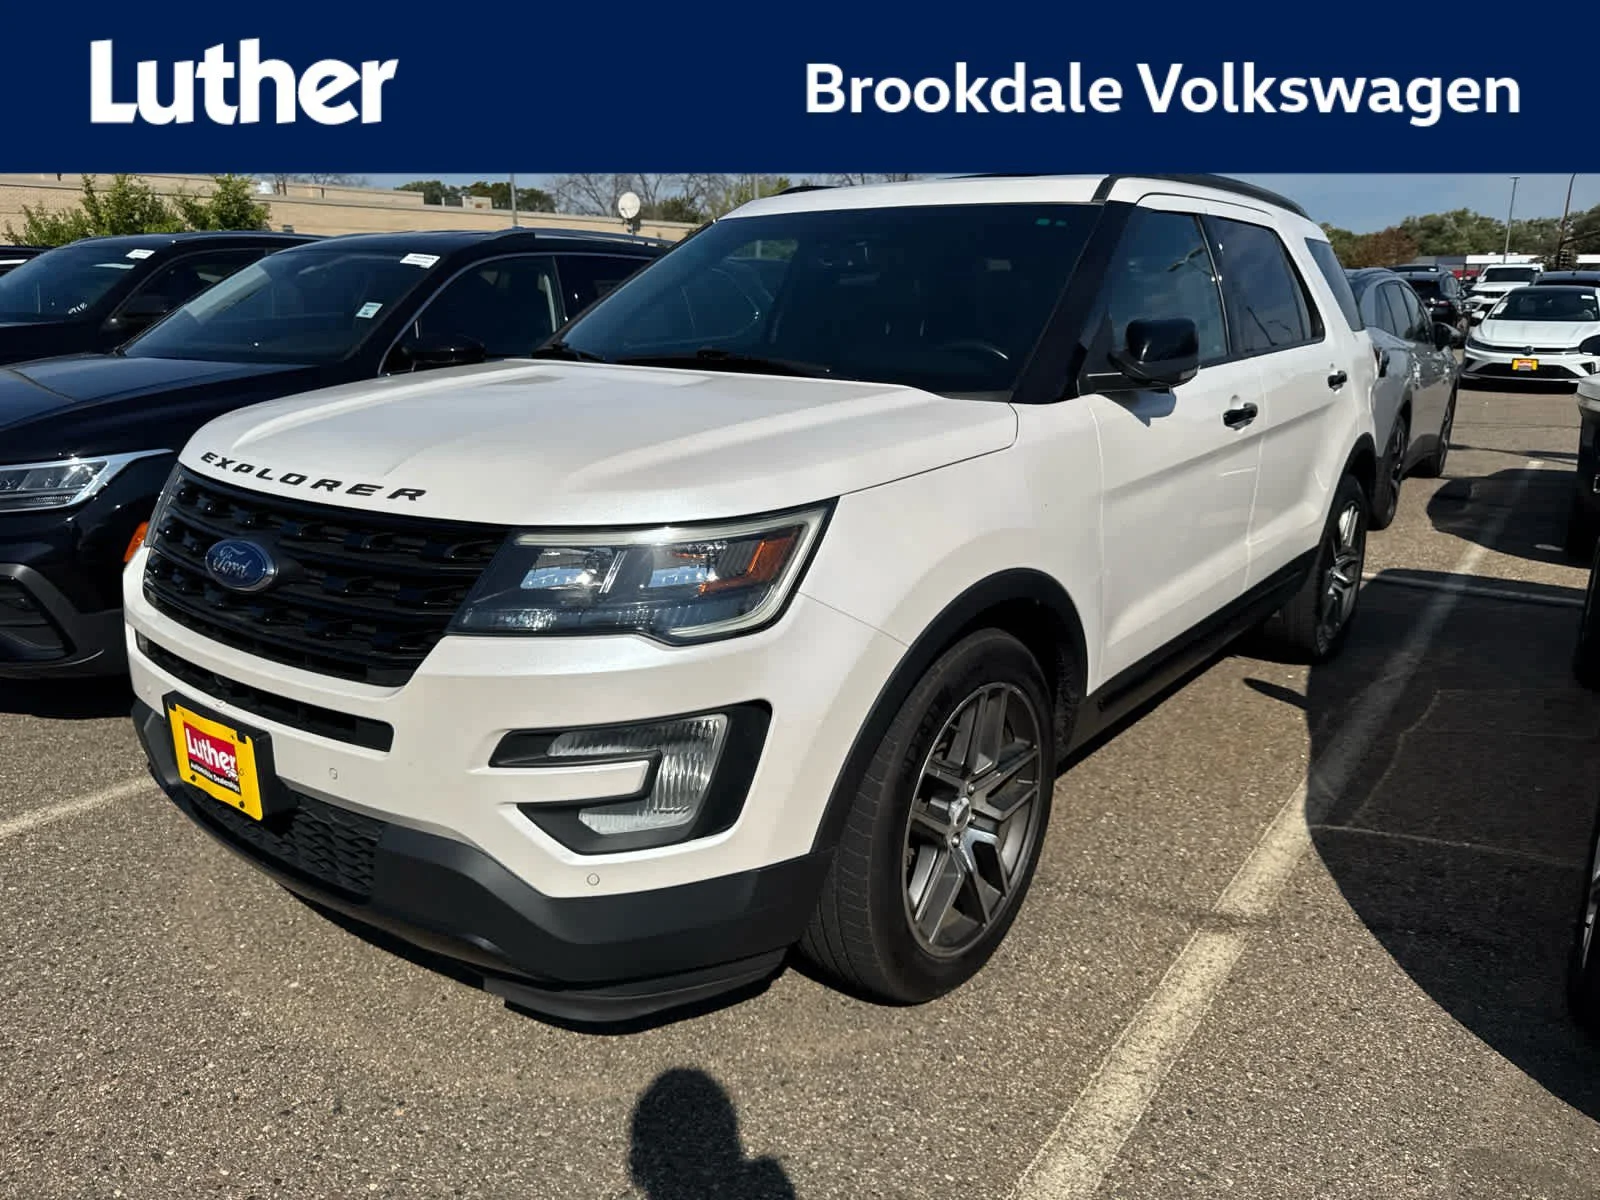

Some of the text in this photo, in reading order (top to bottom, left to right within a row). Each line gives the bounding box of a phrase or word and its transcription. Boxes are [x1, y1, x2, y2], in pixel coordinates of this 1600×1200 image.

[200, 451, 427, 501] EXPLORER
[213, 545, 251, 578] Ford
[185, 727, 237, 770] Luther
